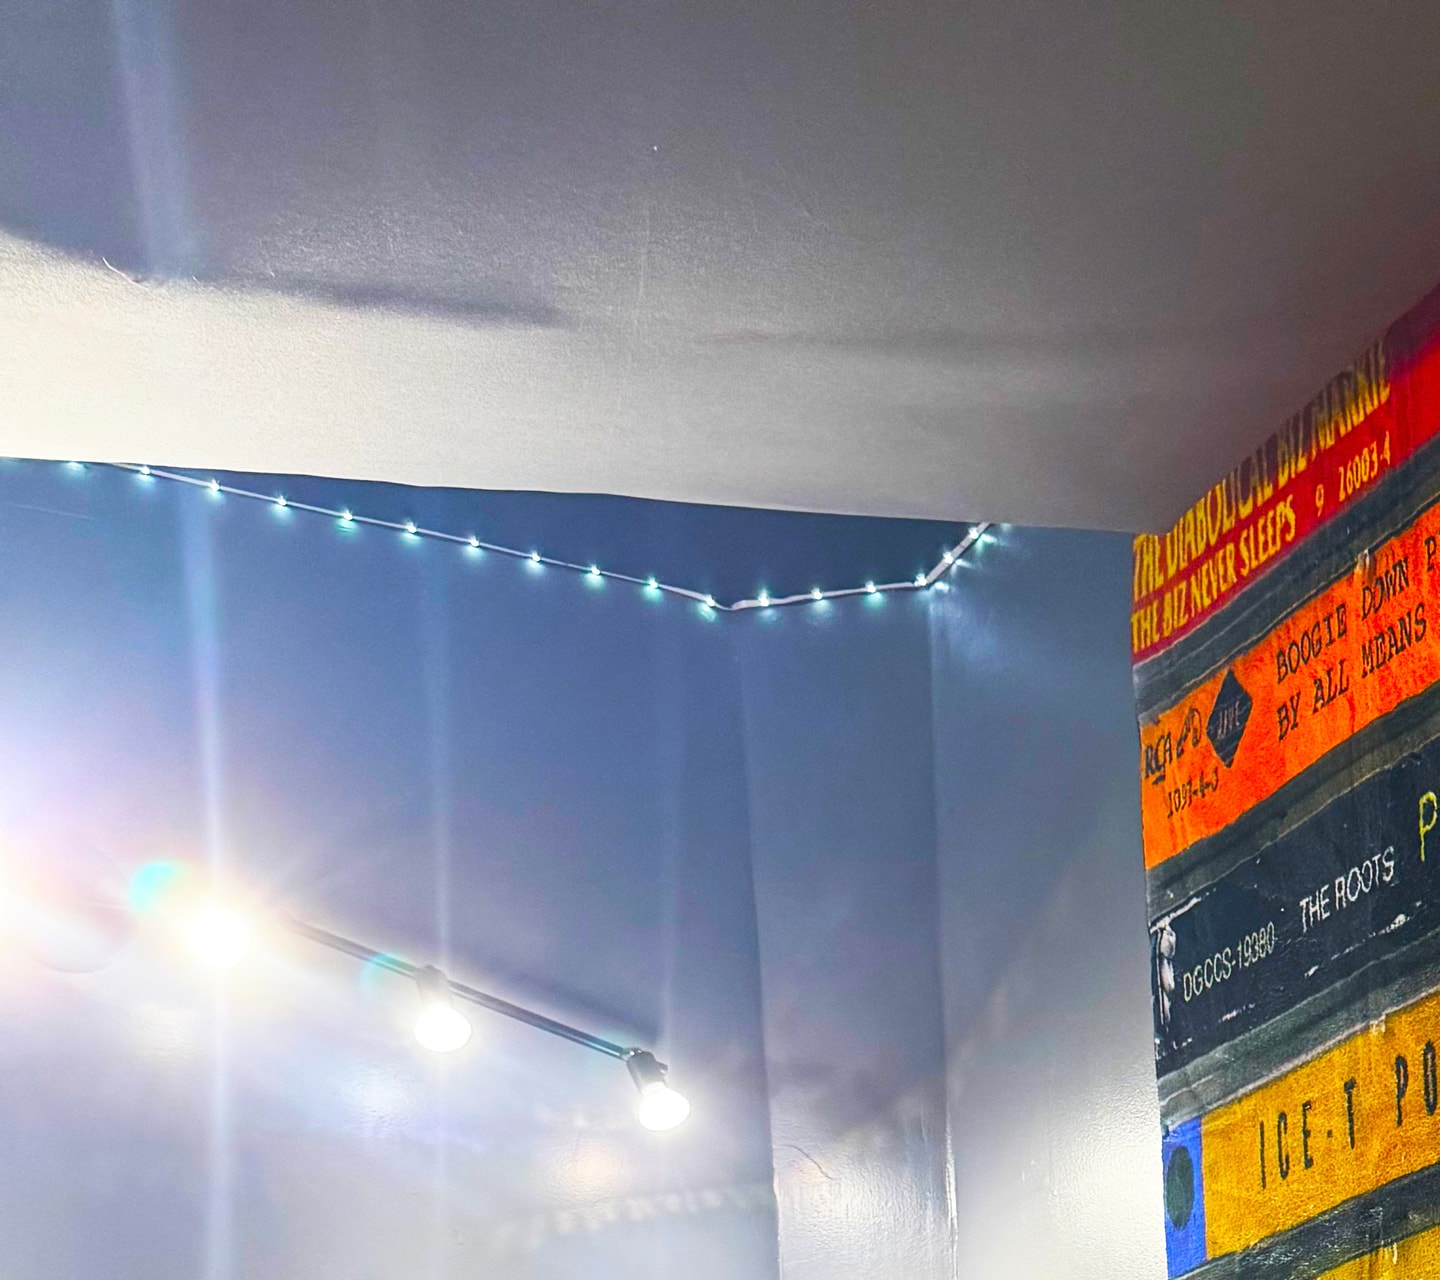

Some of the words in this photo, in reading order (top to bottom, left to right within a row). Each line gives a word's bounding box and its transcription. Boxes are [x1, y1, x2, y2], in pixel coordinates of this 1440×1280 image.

[1131, 602, 1160, 653] THE
[1162, 581, 1188, 638] BIZ
[1190, 542, 1237, 618] NEVER
[1240, 494, 1296, 578] SLEEPS
[1276, 604, 1347, 684] BOOGIE
[1360, 556, 1410, 622] DOWN
[1277, 692, 1302, 742] BY
[1312, 659, 1350, 714] ALL
[1360, 604, 1427, 679] MEANS
[1299, 889, 1330, 934] THE
[1334, 846, 1396, 910] ROOTS
